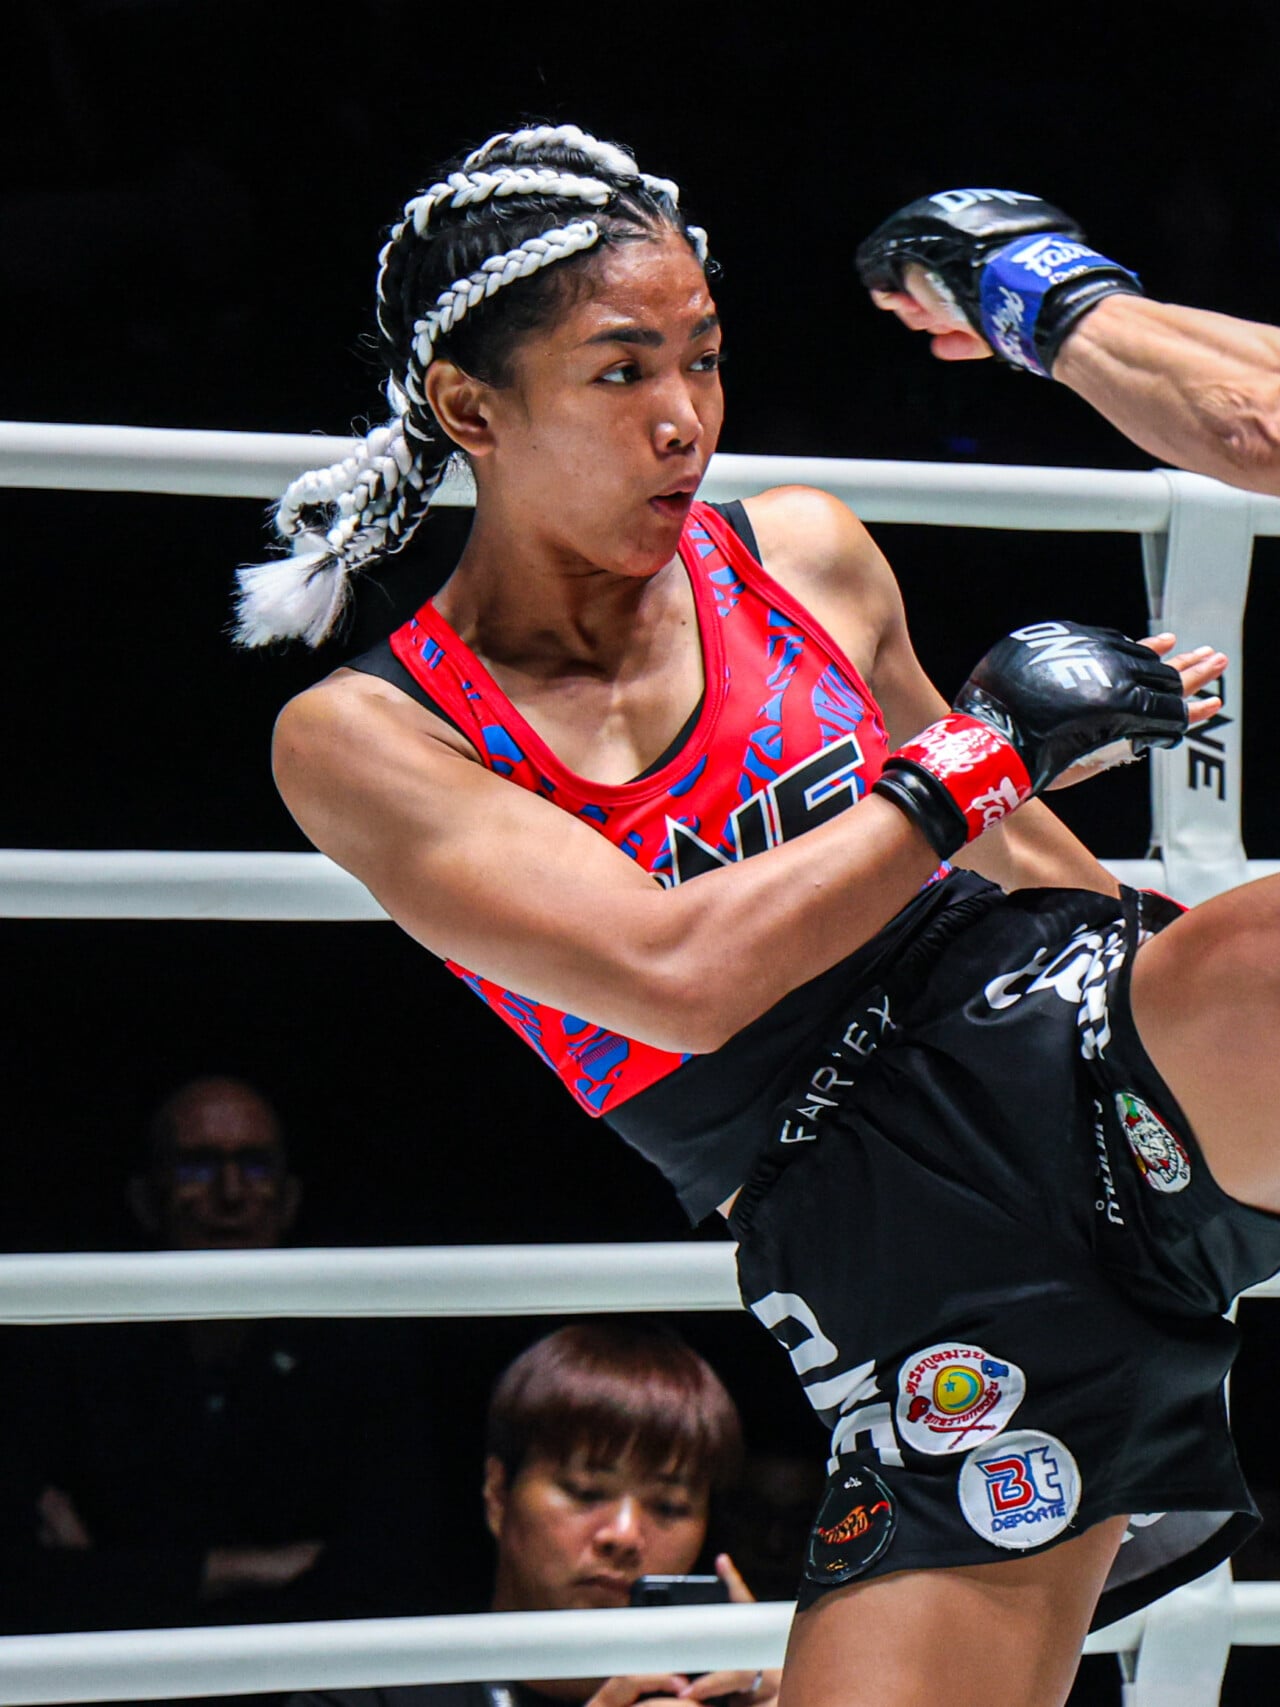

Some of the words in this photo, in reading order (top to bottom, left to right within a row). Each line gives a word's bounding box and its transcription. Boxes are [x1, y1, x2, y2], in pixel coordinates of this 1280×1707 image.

[929, 188, 1043, 213] ON
[1009, 622, 1112, 690] ONE
[650, 732, 865, 890] NE
[780, 994, 896, 1143] FAIREX
[750, 1290, 905, 1477] ONE
[991, 1501, 1067, 1532] DEPORTE
